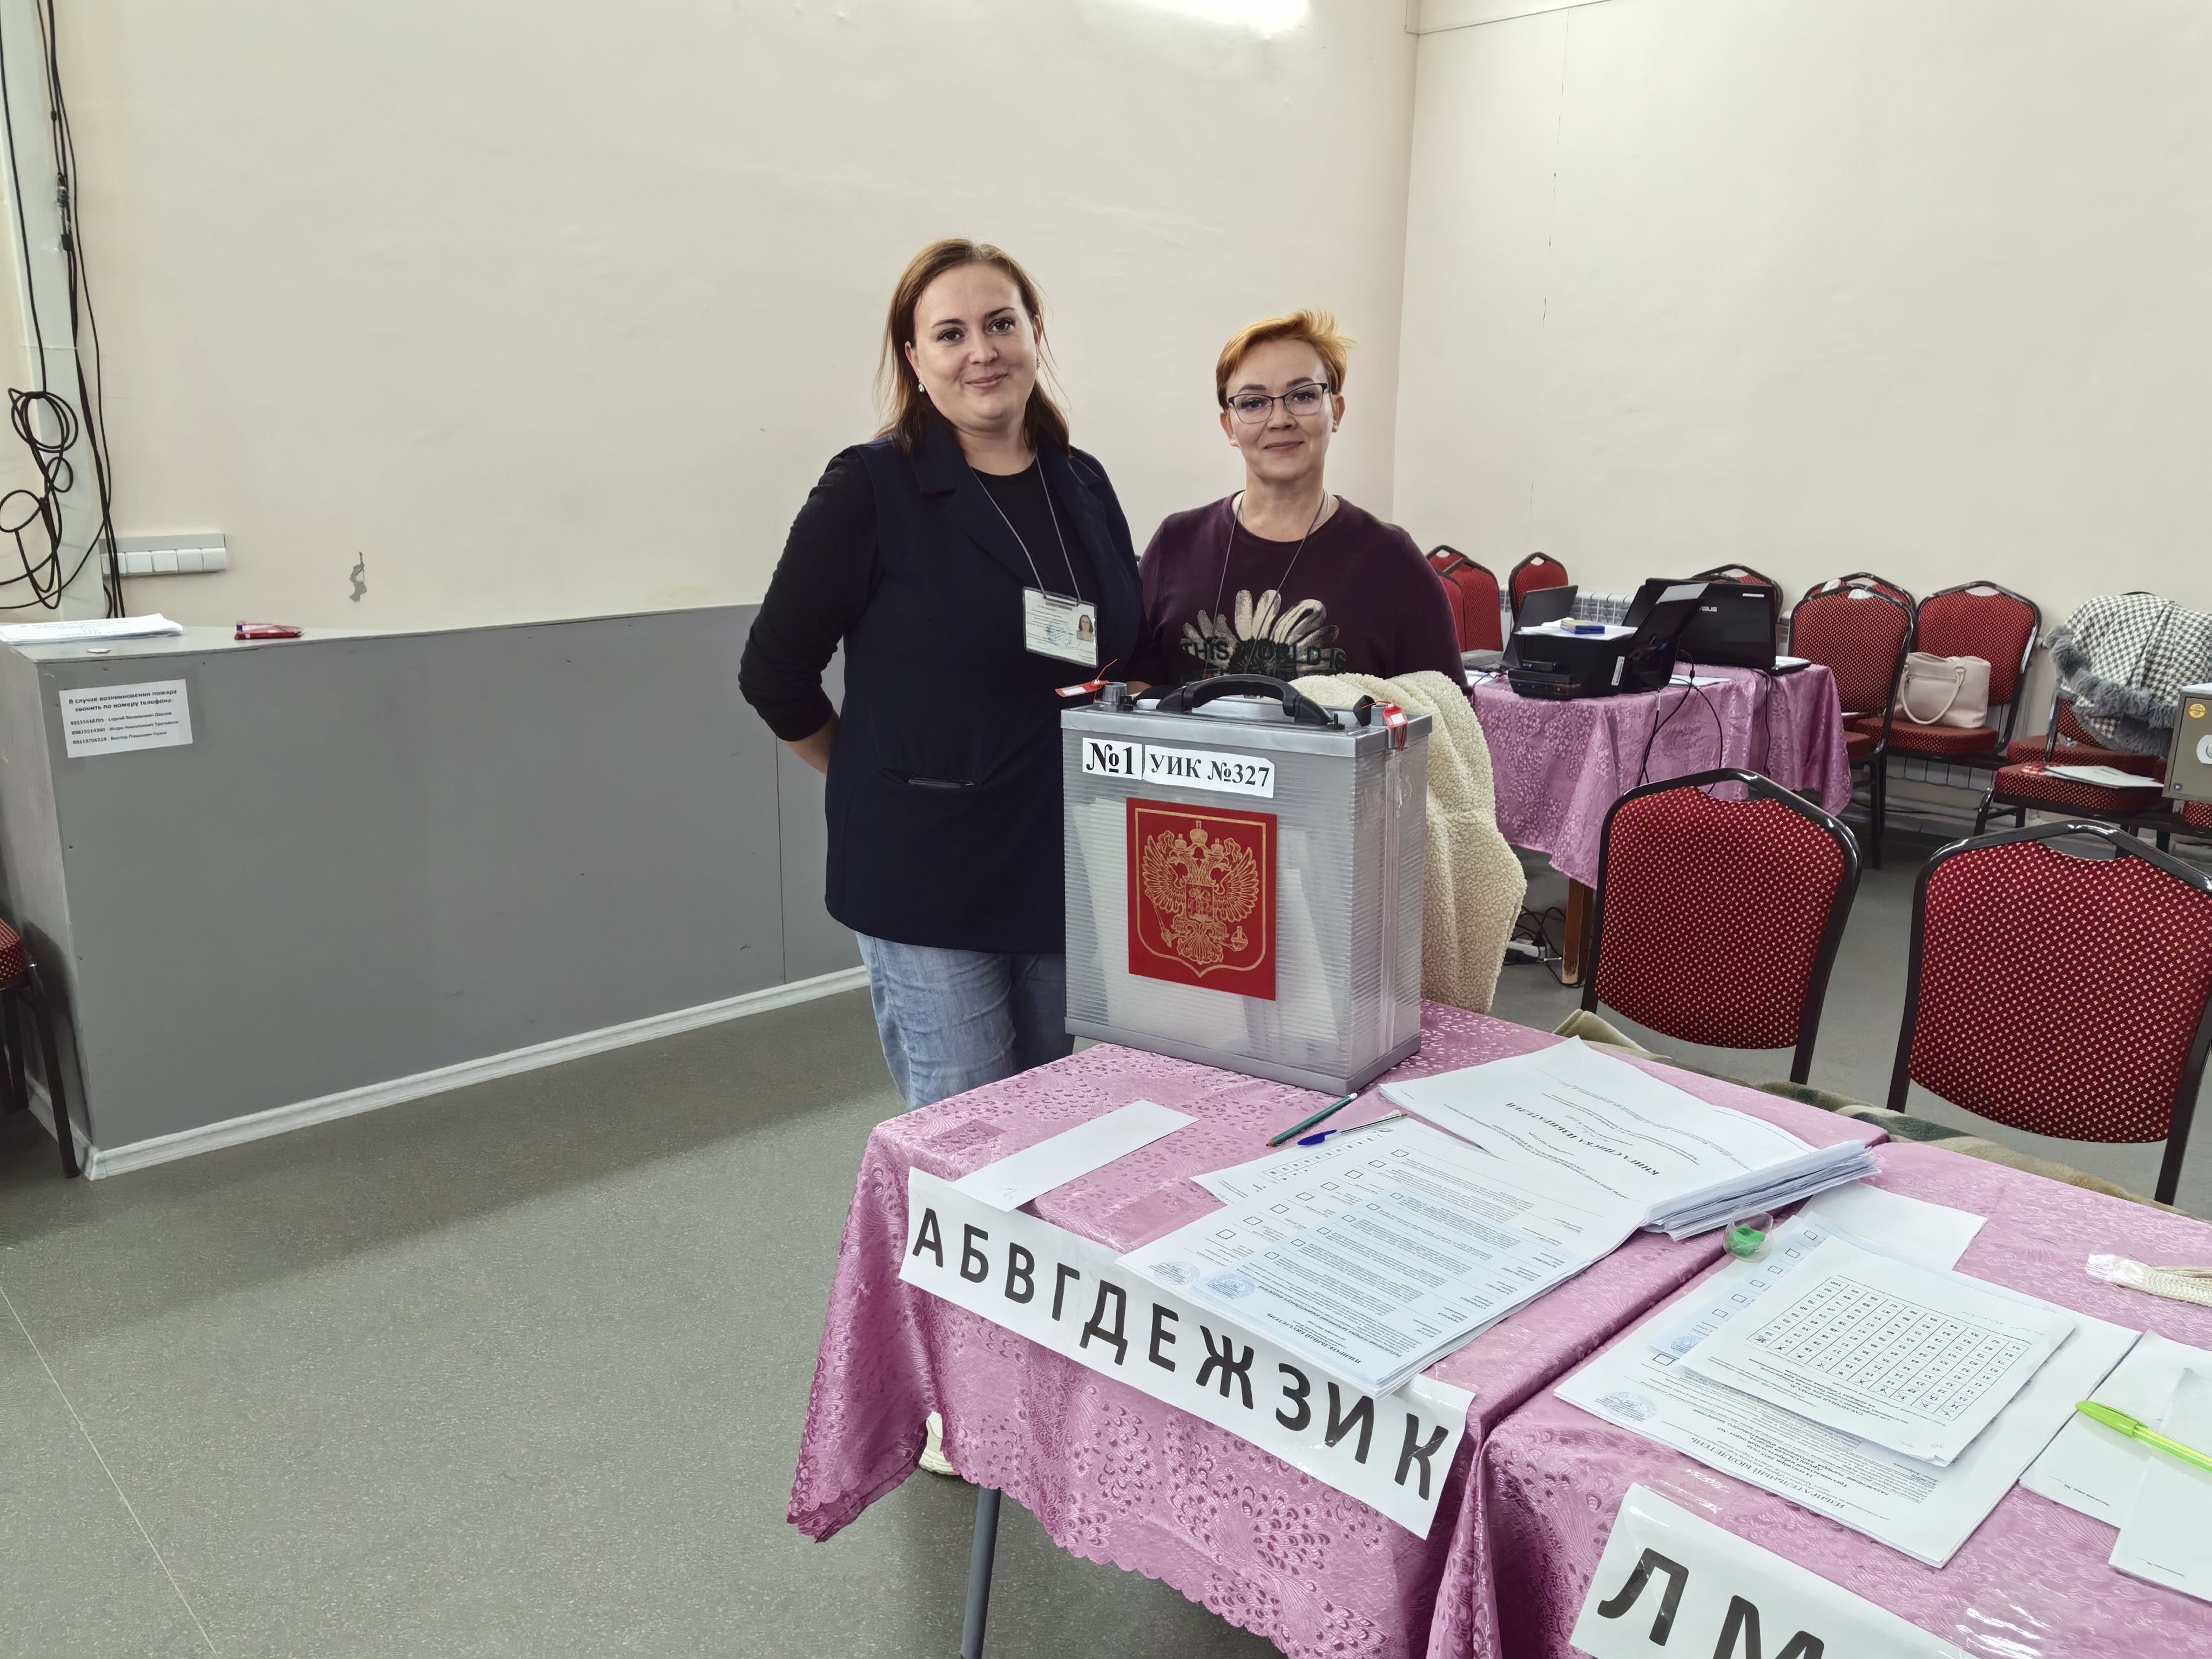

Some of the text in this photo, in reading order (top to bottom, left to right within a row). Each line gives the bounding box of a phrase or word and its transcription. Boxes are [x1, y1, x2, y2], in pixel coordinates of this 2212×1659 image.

[1180, 640, 1230, 661] THIS
[99, 692, 150, 701] возникновения
[112, 701, 138, 709] номеру
[1085, 742, 1136, 776] №1
[1149, 753, 1270, 787] УИК №327
[1503, 1102, 1579, 1139] ИЗБИРАТЕЛЕЙ
[1575, 1138, 1624, 1156] СПИСКА
[1620, 1155, 1661, 1176] КНИГА
[913, 1208, 943, 1267] А
[961, 1224, 988, 1283] Б
[1005, 1243, 1034, 1303] В
[1053, 1263, 1080, 1320] Г
[1080, 1280, 1128, 1365] Д
[1149, 1303, 1178, 1372] Е
[1196, 1325, 1254, 1409] Ж
[1276, 1363, 1311, 1431] З
[1325, 1382, 1374, 1464] И
[1395, 1413, 1448, 1500] К
[1728, 1431, 1750, 1441] округ
[1689, 1437, 1752, 1470] БЮЛЛЕТЕНЬ
[1744, 1445, 1761, 1453] года
[1745, 1440, 1797, 1465] избирательный
[1747, 1436, 1823, 1471] Архангельская область
[1758, 1452, 1776, 1460] 2025
[1776, 1459, 1807, 1474] сентября
[1751, 1467, 1845, 1509] ИЗБИРАТЕЛЬНЫЙ
[1598, 1548, 1689, 1646] Л
